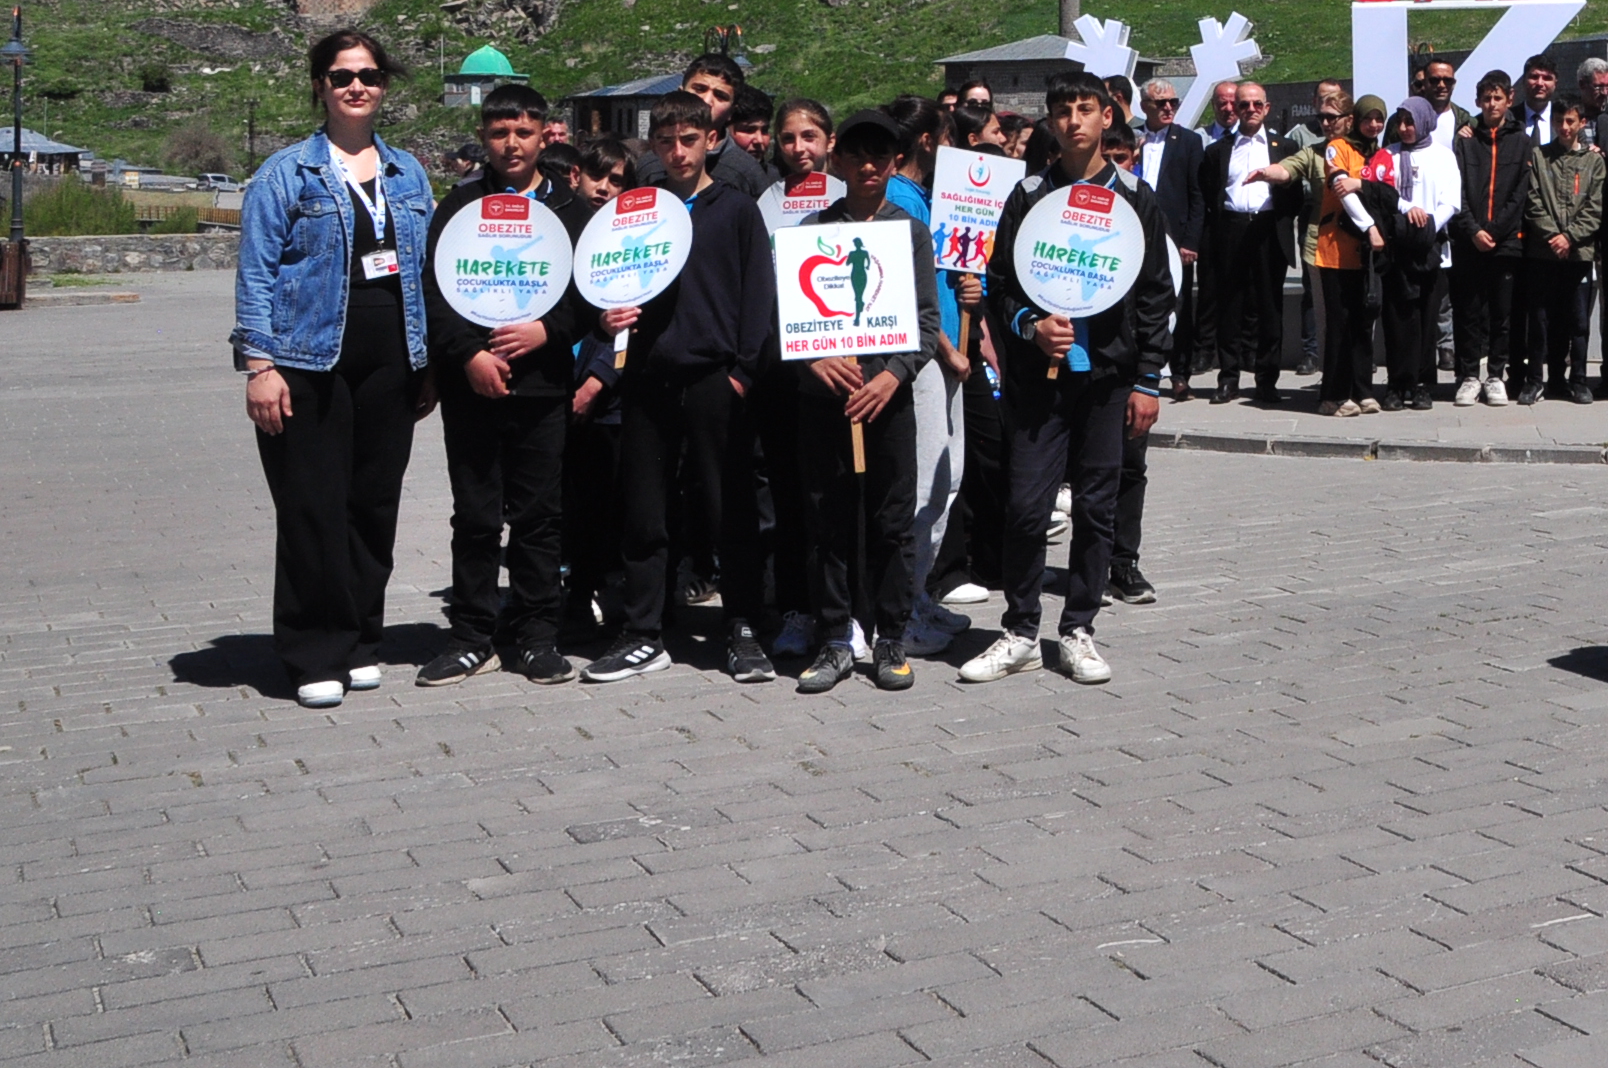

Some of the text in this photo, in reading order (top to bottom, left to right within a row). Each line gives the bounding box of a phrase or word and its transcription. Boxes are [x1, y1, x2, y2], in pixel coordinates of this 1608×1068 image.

[941, 192, 992, 206] SAĞLIĞIMIZ
[955, 205, 994, 216] HER GÜN
[962, 214, 977, 224] BİN
[591, 241, 673, 269] HAREKETE
[1033, 240, 1122, 272] HAREKETE
[456, 258, 551, 278] HAREKETE
[591, 258, 669, 279] ÇOCUKLUKTA BAŞLA
[1031, 260, 1115, 283] ÇOCUKLUKTA BAŞLA
[457, 279, 548, 288] ÇOCUKLUKTA BAŞLA
[786, 315, 897, 334] OBEZİTEYE KARŞI
[786, 332, 907, 352] HER GÜN 10 BİN ADIM
